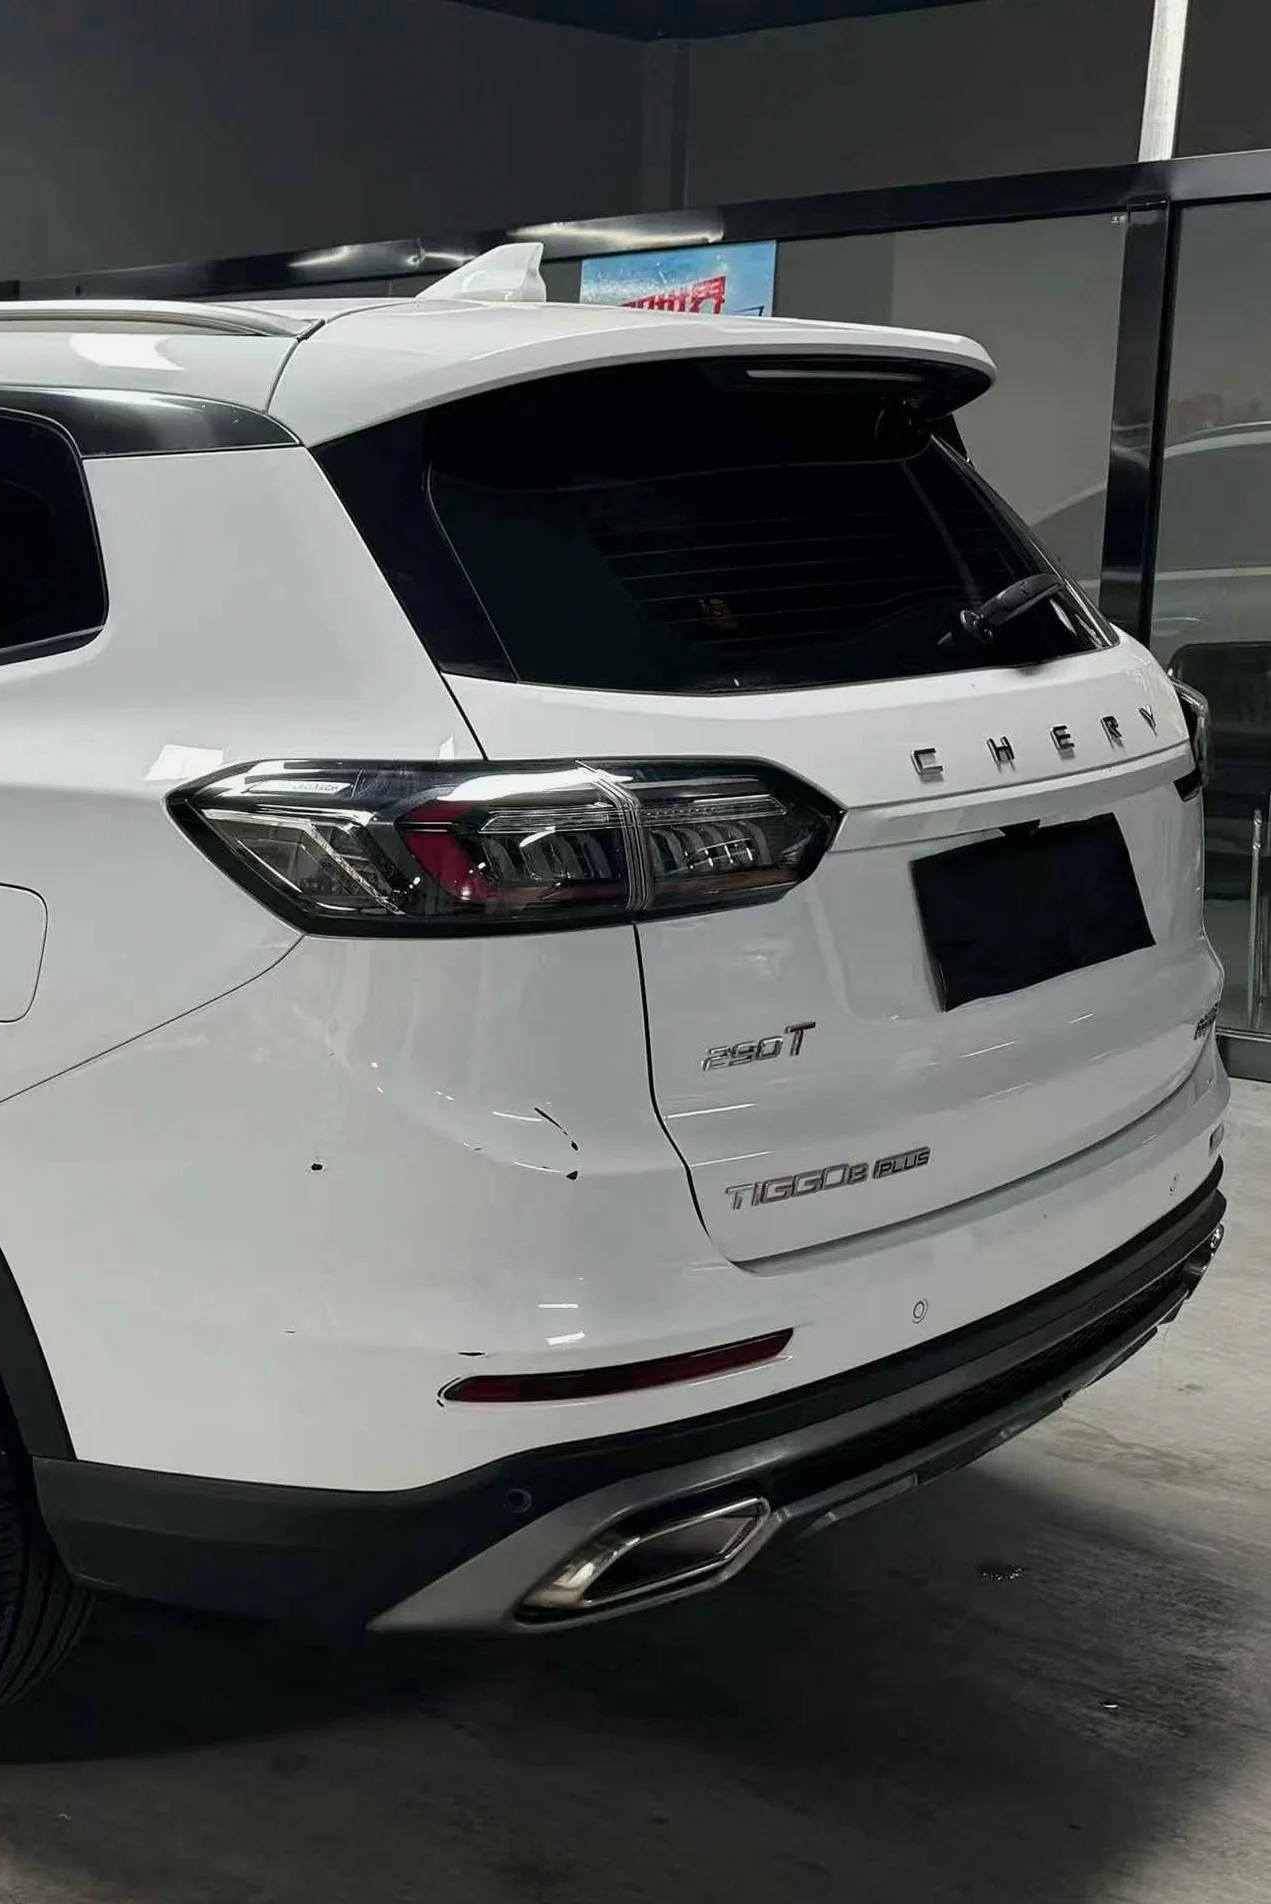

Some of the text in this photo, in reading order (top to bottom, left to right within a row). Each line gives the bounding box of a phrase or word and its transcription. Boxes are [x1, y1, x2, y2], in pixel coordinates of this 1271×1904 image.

[911, 705, 1158, 776] CHERY
[701, 1021, 817, 1072] 290T
[875, 1147, 931, 1179] PLUS
